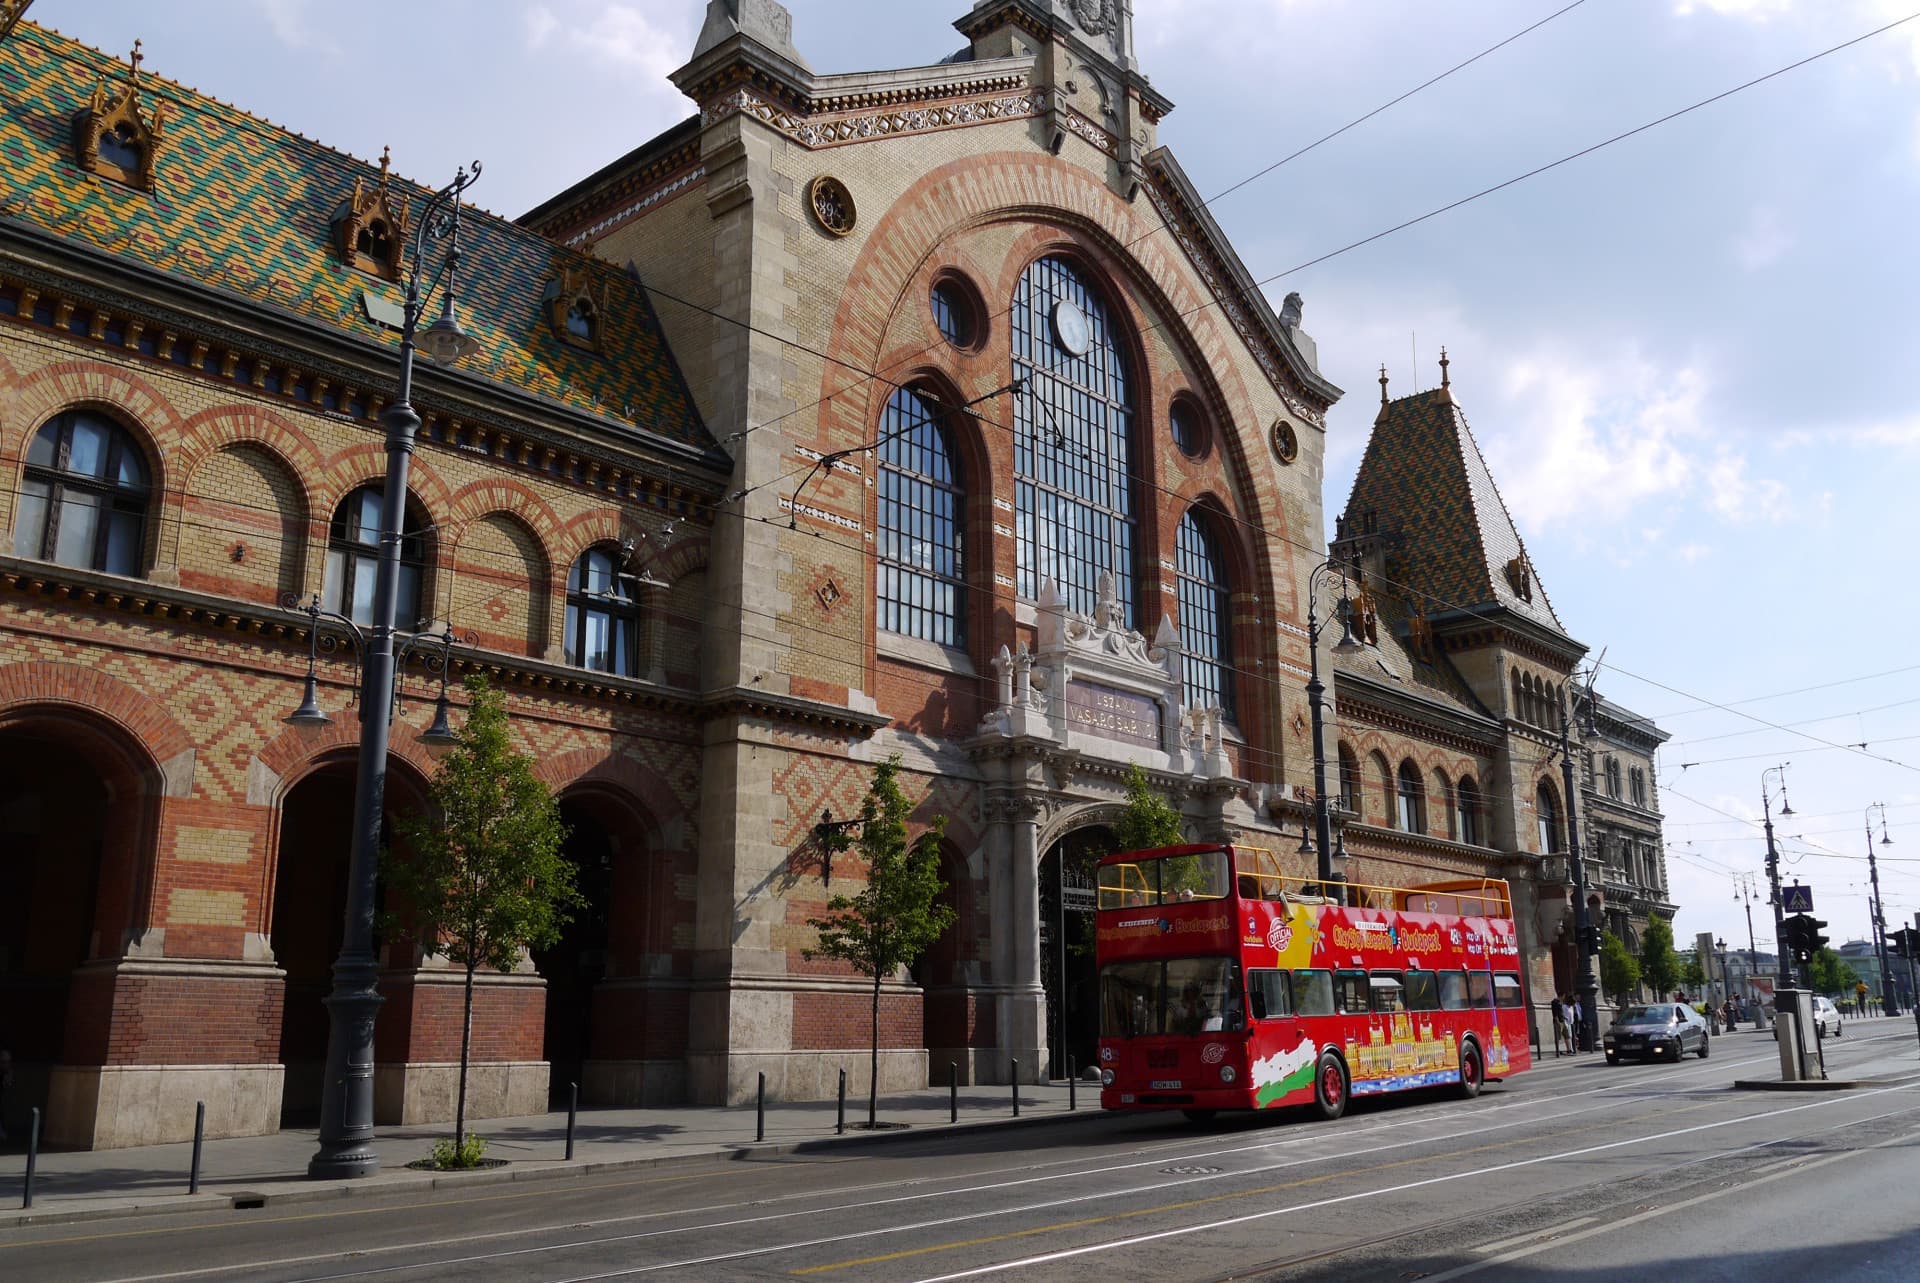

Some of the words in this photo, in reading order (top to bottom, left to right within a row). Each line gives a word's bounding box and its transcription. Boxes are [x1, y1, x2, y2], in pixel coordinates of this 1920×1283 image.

[1175, 915, 1230, 933] Budapest
[1269, 927, 1292, 944] OFFICIAL
[1400, 927, 1442, 955] Budapest
[1101, 1047, 1112, 1061] 48
